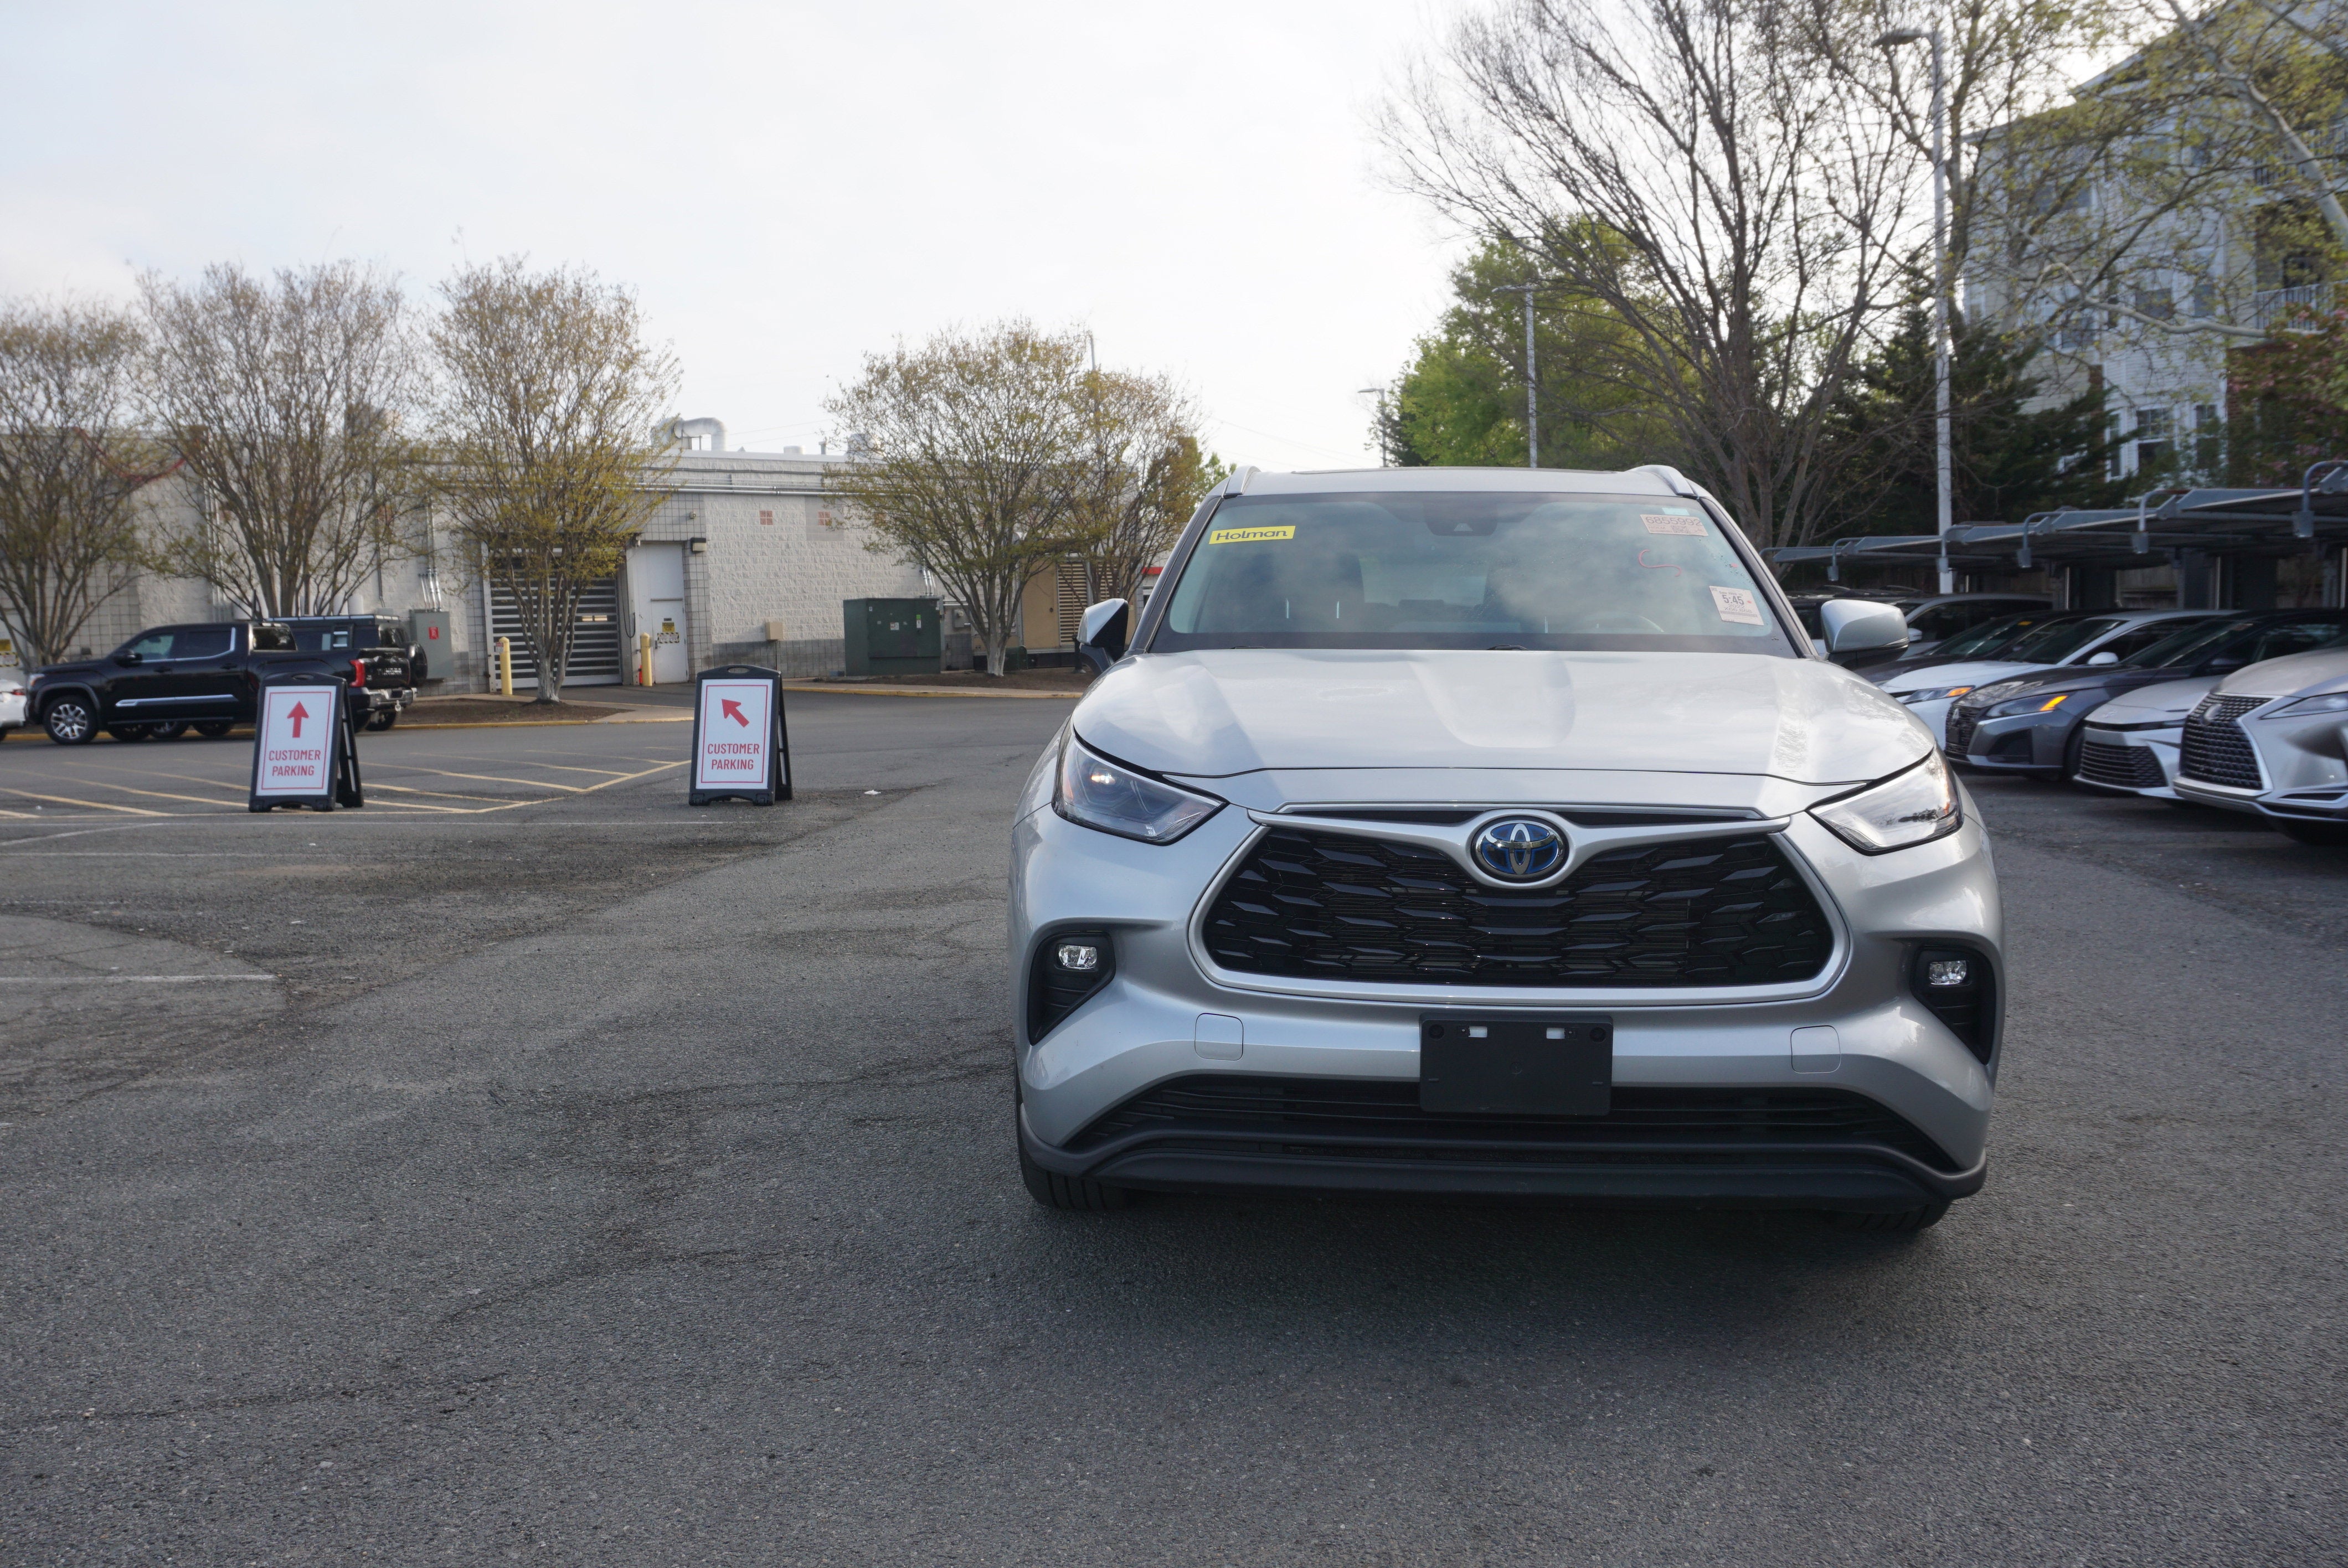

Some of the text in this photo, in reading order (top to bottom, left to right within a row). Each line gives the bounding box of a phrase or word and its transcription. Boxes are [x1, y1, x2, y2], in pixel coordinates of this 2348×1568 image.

[1645, 517, 1703, 526] 6855992
[1216, 530, 1288, 541] Holman
[1722, 594, 1744, 605] 5:45
[707, 743, 760, 754] CUSTOMER
[269, 750, 321, 761] CUSTOMER
[711, 759, 754, 770] PARKING
[272, 765, 315, 776] PARKING
